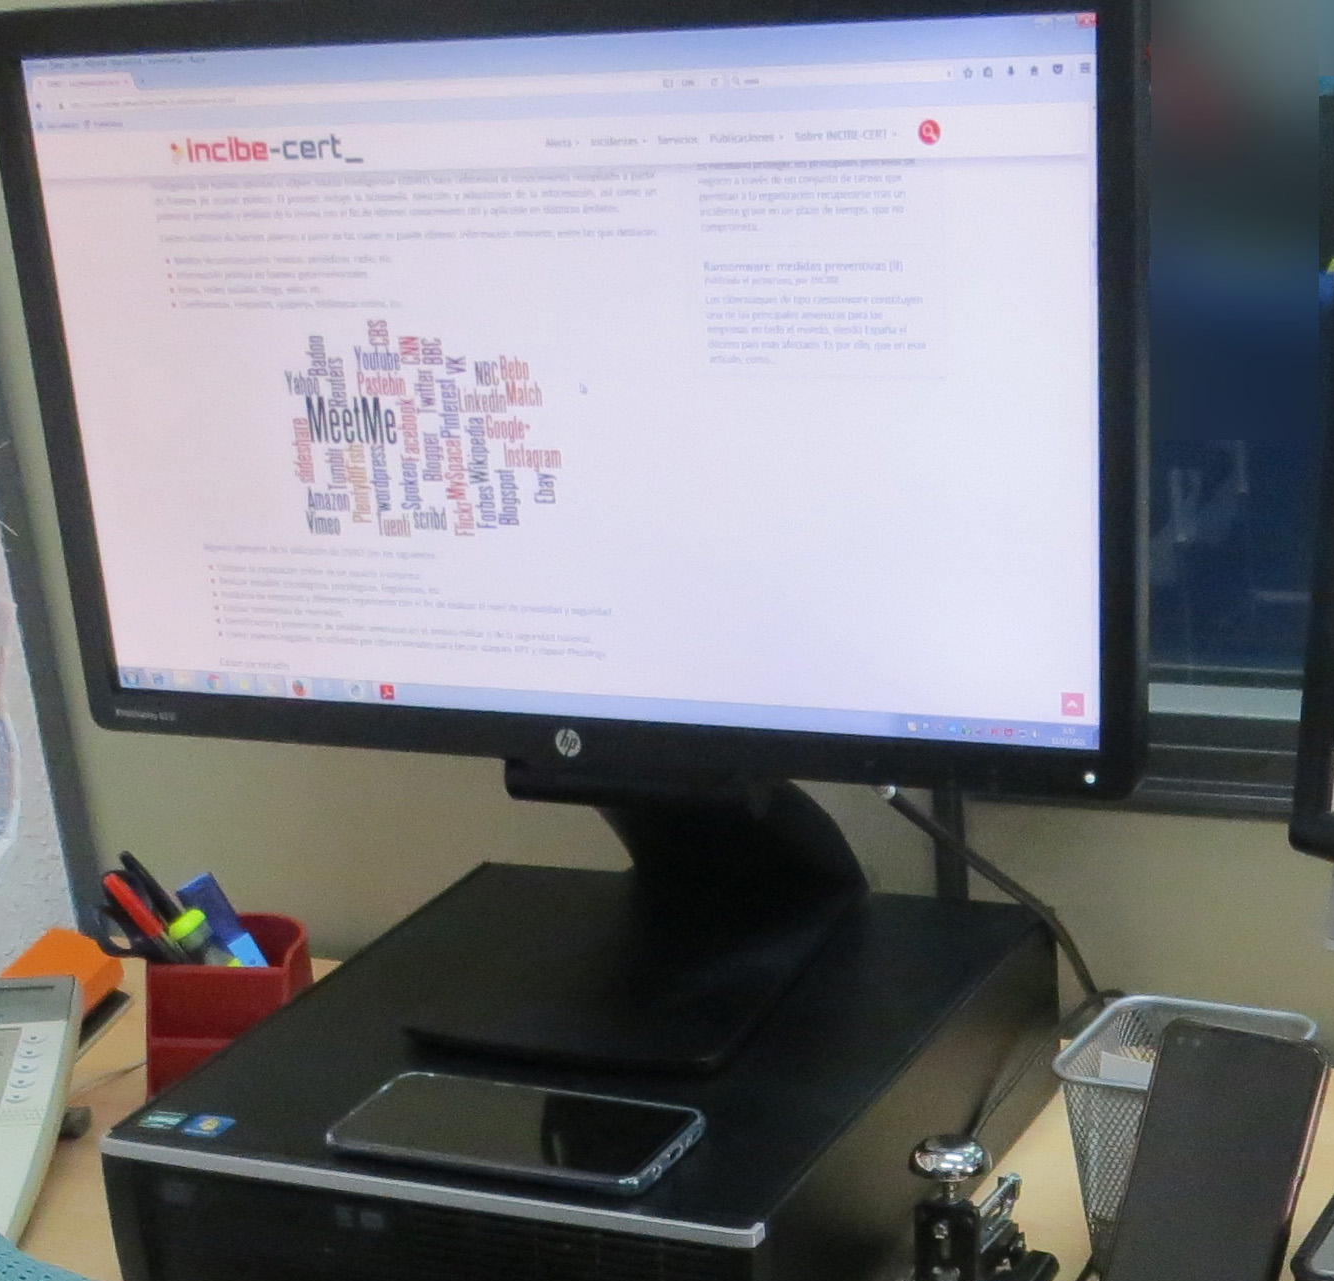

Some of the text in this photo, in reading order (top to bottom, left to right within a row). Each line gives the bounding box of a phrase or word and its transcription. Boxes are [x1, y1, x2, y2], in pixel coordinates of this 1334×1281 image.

[709, 132, 774, 145] Publicaciones
[794, 130, 823, 142] Sobre
[776, 260, 821, 272] medidas
[824, 261, 886, 275] preventivas
[367, 319, 390, 348] CBS
[307, 335, 328, 377] Badoo
[353, 346, 401, 372] Youtube
[398, 336, 421, 365] CNN
[421, 338, 443, 365] BBC
[445, 355, 467, 375] VK
[285, 370, 321, 396] Yahoo
[326, 357, 348, 408] Reuters
[474, 361, 500, 386] NBC
[499, 355, 530, 382] Bebo
[356, 370, 407, 397] Pastebin
[415, 369, 436, 413] Twitter
[505, 381, 544, 408] Match
[436, 378, 460, 439] Pinterest
[457, 388, 507, 414] LinkedIn
[306, 396, 397, 445] MeetMe
[395, 398, 420, 462] Facebook
[422, 432, 443, 482] Blogger
[464, 417, 489, 485] Wikipedia
[503, 443, 562, 472] Instagram
[445, 439, 468, 500] MySpace
[307, 486, 351, 511] Amazon
[401, 460, 421, 510] Spokeo
[494, 468, 520, 526] Blogspot
[454, 500, 476, 537] Flickr
[477, 485, 497, 529] Forbes
[306, 511, 341, 536] Vimeo
[556, 729, 582, 757] hp
